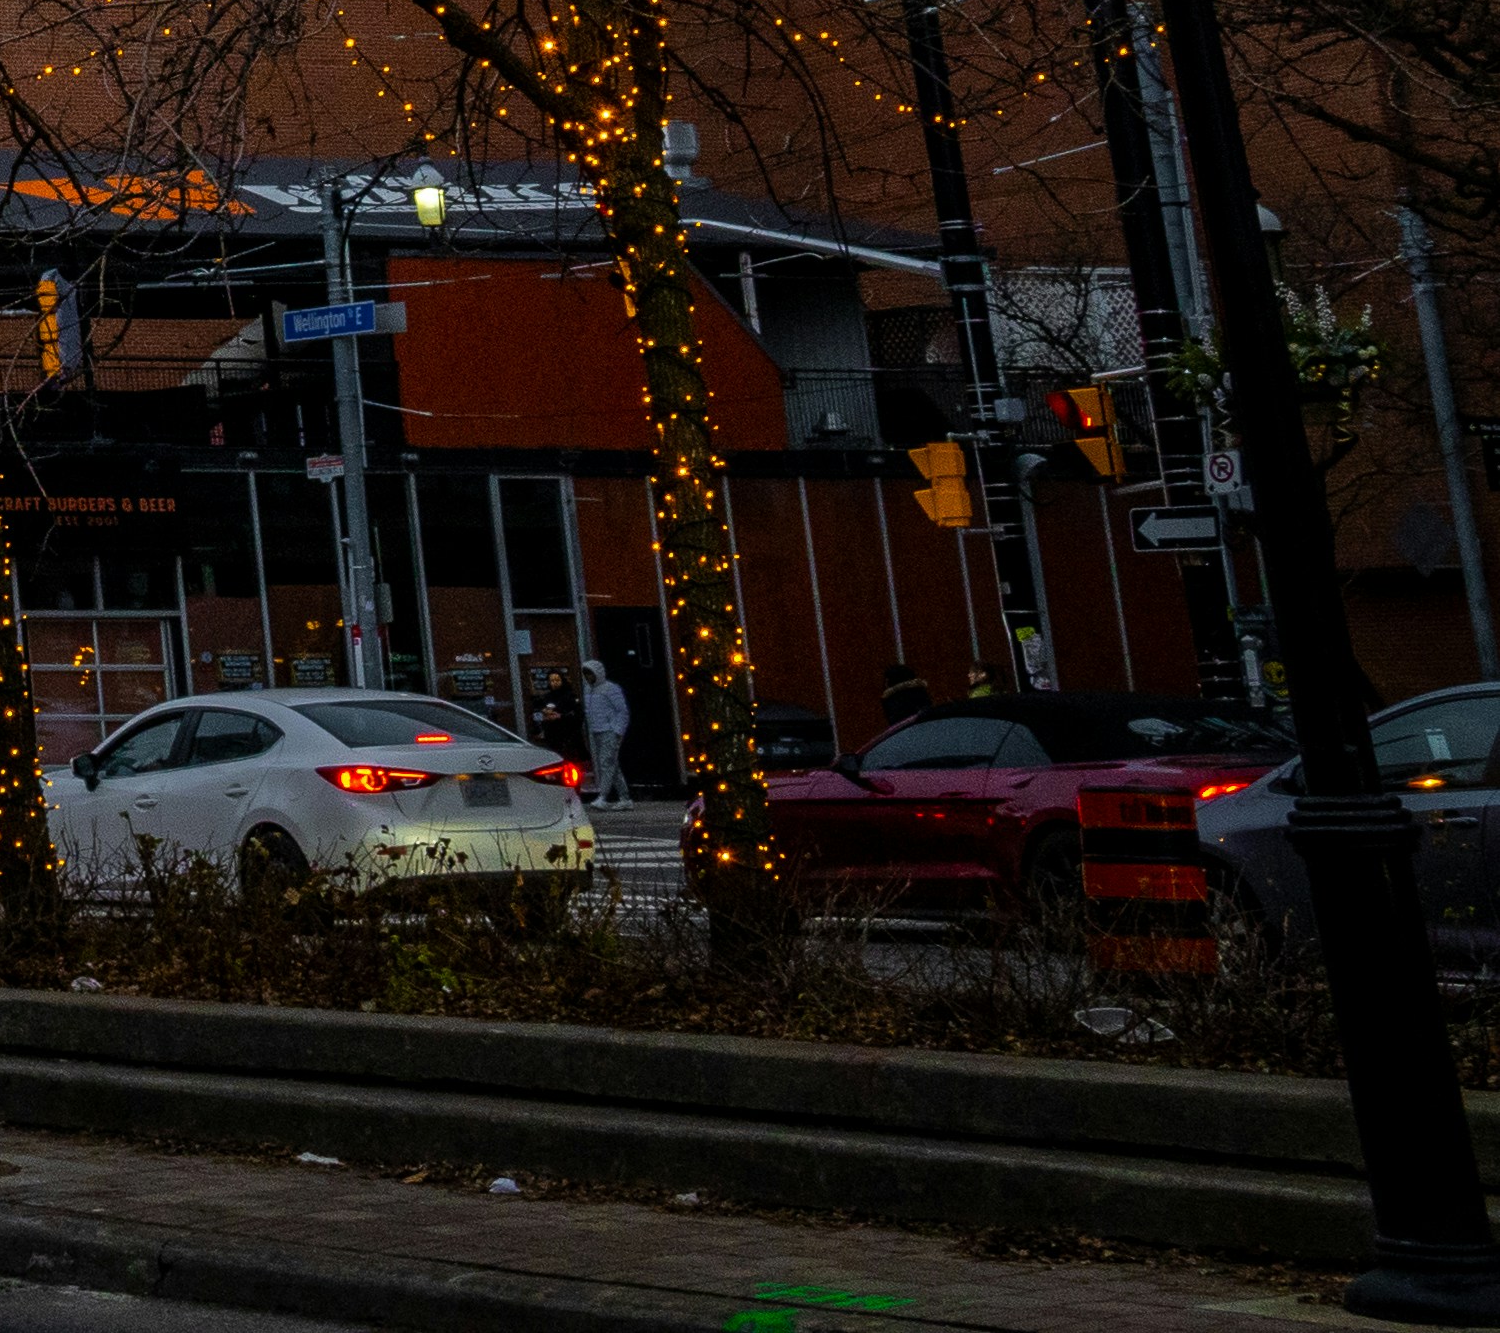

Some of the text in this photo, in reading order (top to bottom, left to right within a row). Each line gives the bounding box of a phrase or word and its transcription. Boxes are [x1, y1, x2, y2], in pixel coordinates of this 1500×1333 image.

[293, 311, 346, 335] Wellington
[355, 306, 362, 326] E
[47, 496, 116, 512] BURGERS
[139, 498, 177, 512] BEER
